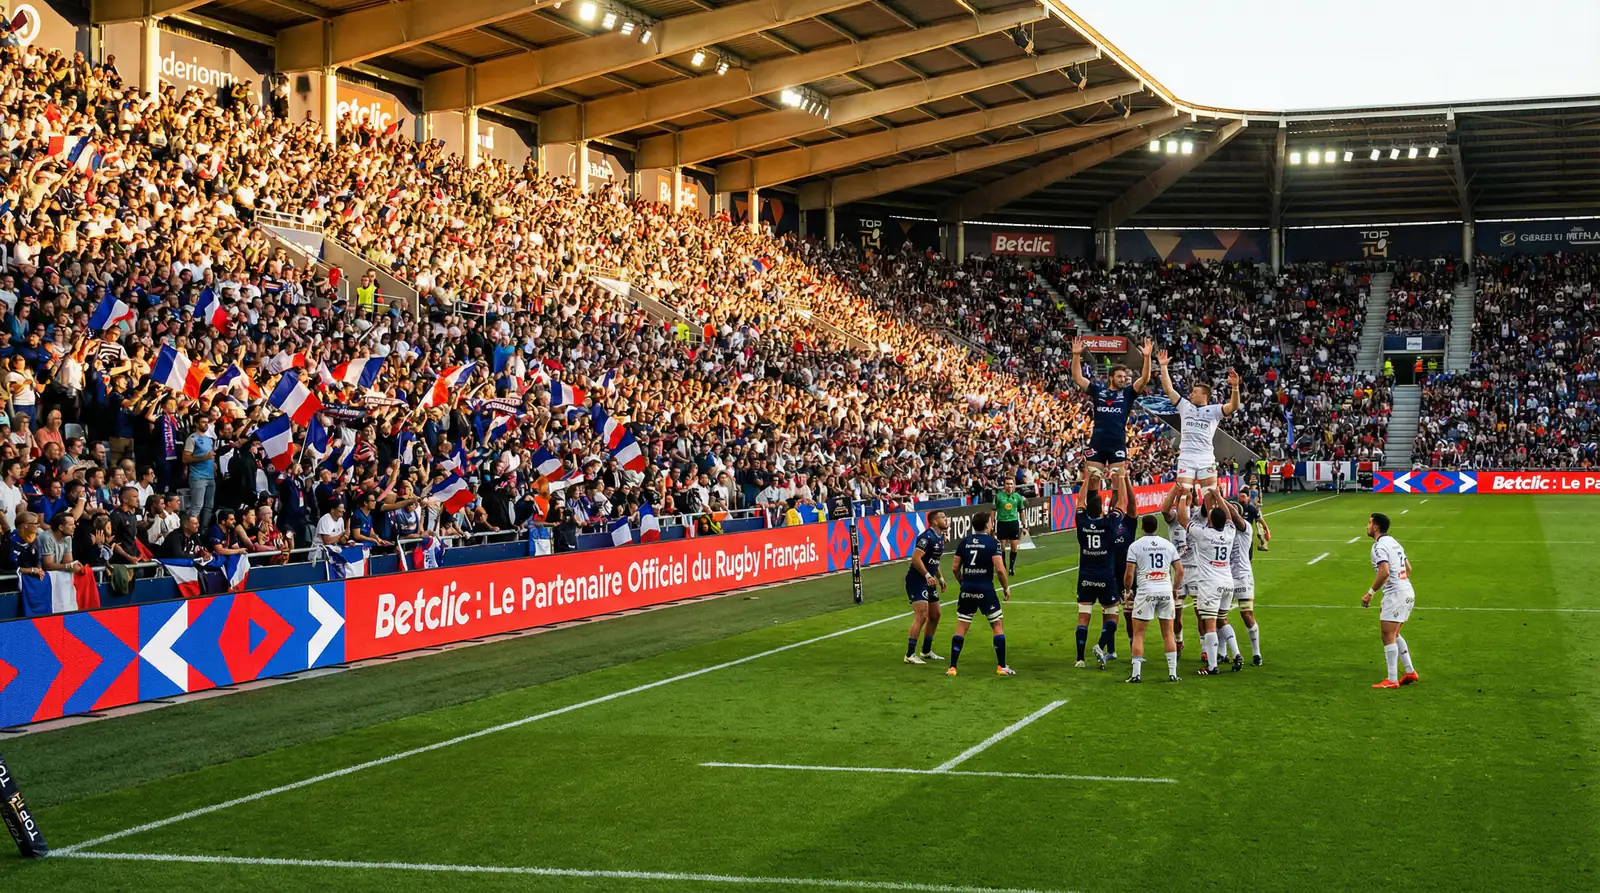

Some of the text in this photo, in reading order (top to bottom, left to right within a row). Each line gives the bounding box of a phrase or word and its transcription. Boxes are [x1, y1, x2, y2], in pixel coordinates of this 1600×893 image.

[336, 98, 392, 132] etclic
[859, 218, 882, 228] TOP
[861, 235, 880, 249] 14
[1360, 230, 1390, 239] TOP
[995, 235, 1051, 253] Betclic
[1362, 246, 1388, 258] 14
[1492, 475, 1550, 490] Betclic
[1562, 477, 1580, 489] Le
[952, 515, 971, 540] TOP
[970, 549, 978, 566] 7
[1214, 546, 1227, 561] 13
[375, 580, 471, 639] Betclic
[489, 582, 515, 617] Le
[522, 565, 623, 611] Partenaire
[627, 553, 688, 593] Officiel
[692, 551, 711, 582] du
[715, 545, 760, 581] Rugby
[0, 765, 10, 788] TO
[20, 810, 39, 842] TOP
